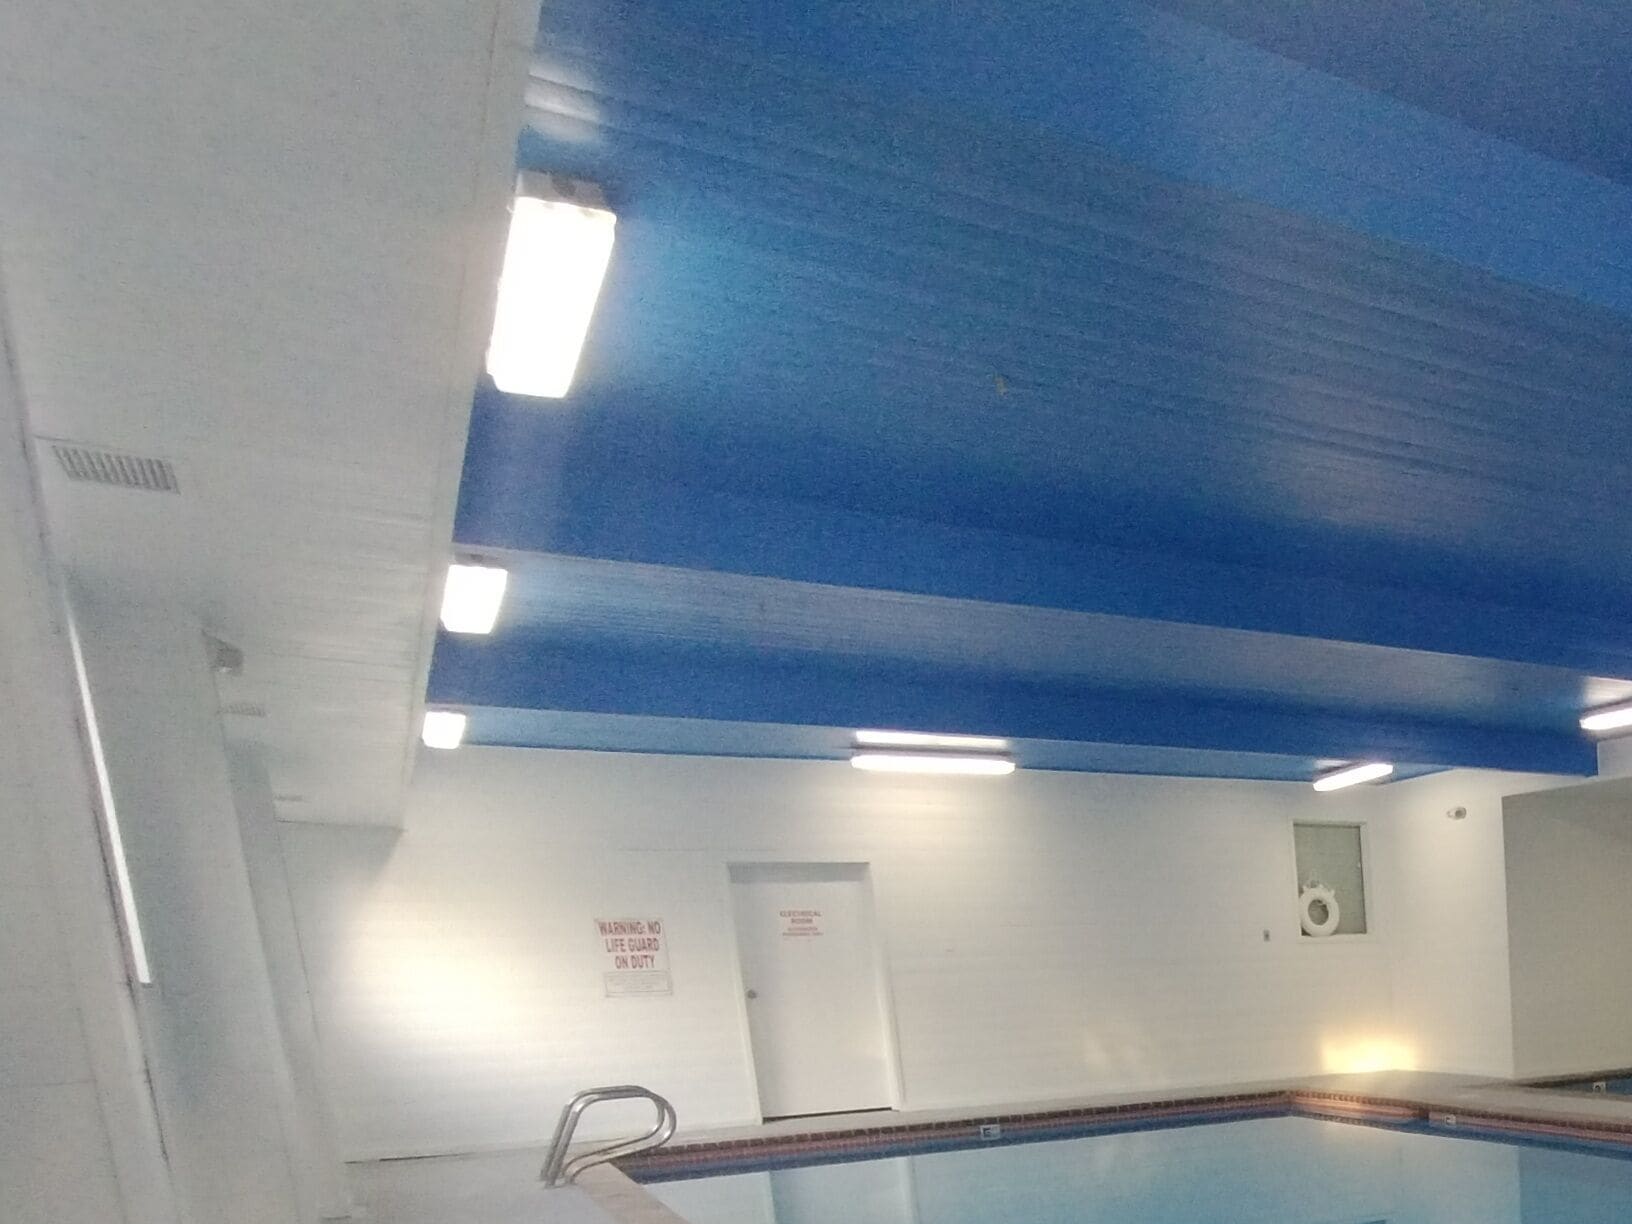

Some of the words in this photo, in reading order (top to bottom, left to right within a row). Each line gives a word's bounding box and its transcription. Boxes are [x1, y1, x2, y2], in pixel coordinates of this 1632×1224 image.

[647, 920, 661, 934] NO
[606, 939, 626, 953] LIFE
[628, 937, 659, 952] GUARD
[615, 955, 628, 969] ON
[630, 954, 655, 969] DUTY
